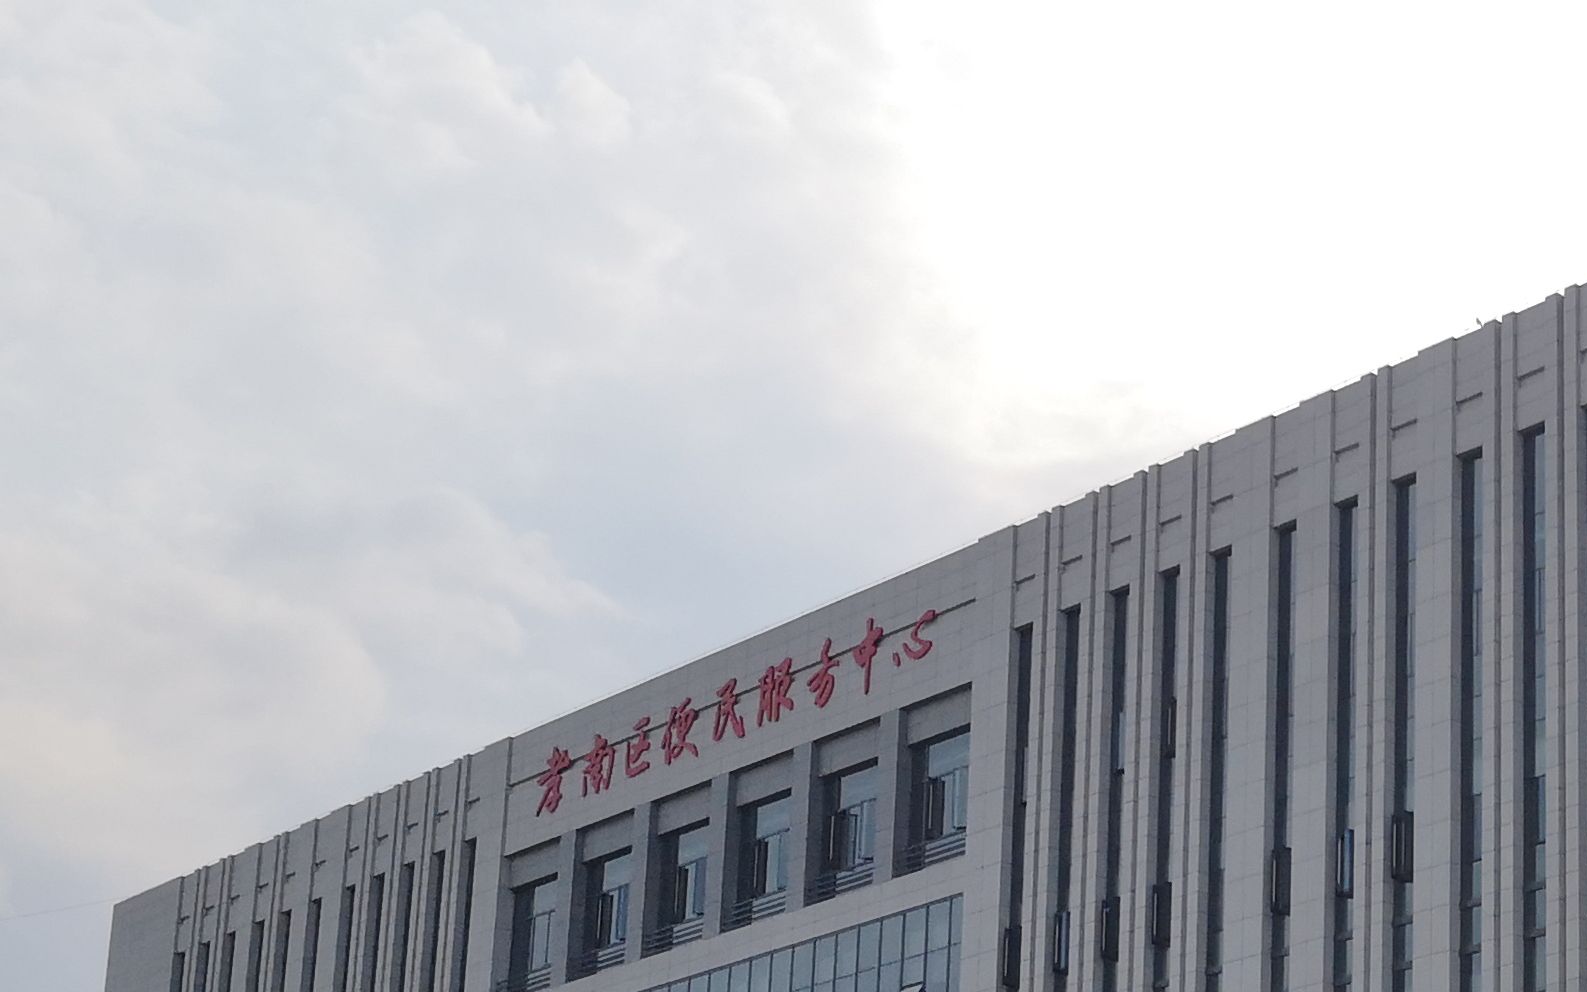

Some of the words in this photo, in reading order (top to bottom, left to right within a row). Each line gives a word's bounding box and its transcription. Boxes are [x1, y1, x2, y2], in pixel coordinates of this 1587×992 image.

[536, 609, 938, 817] 孝南区便民服务中心
